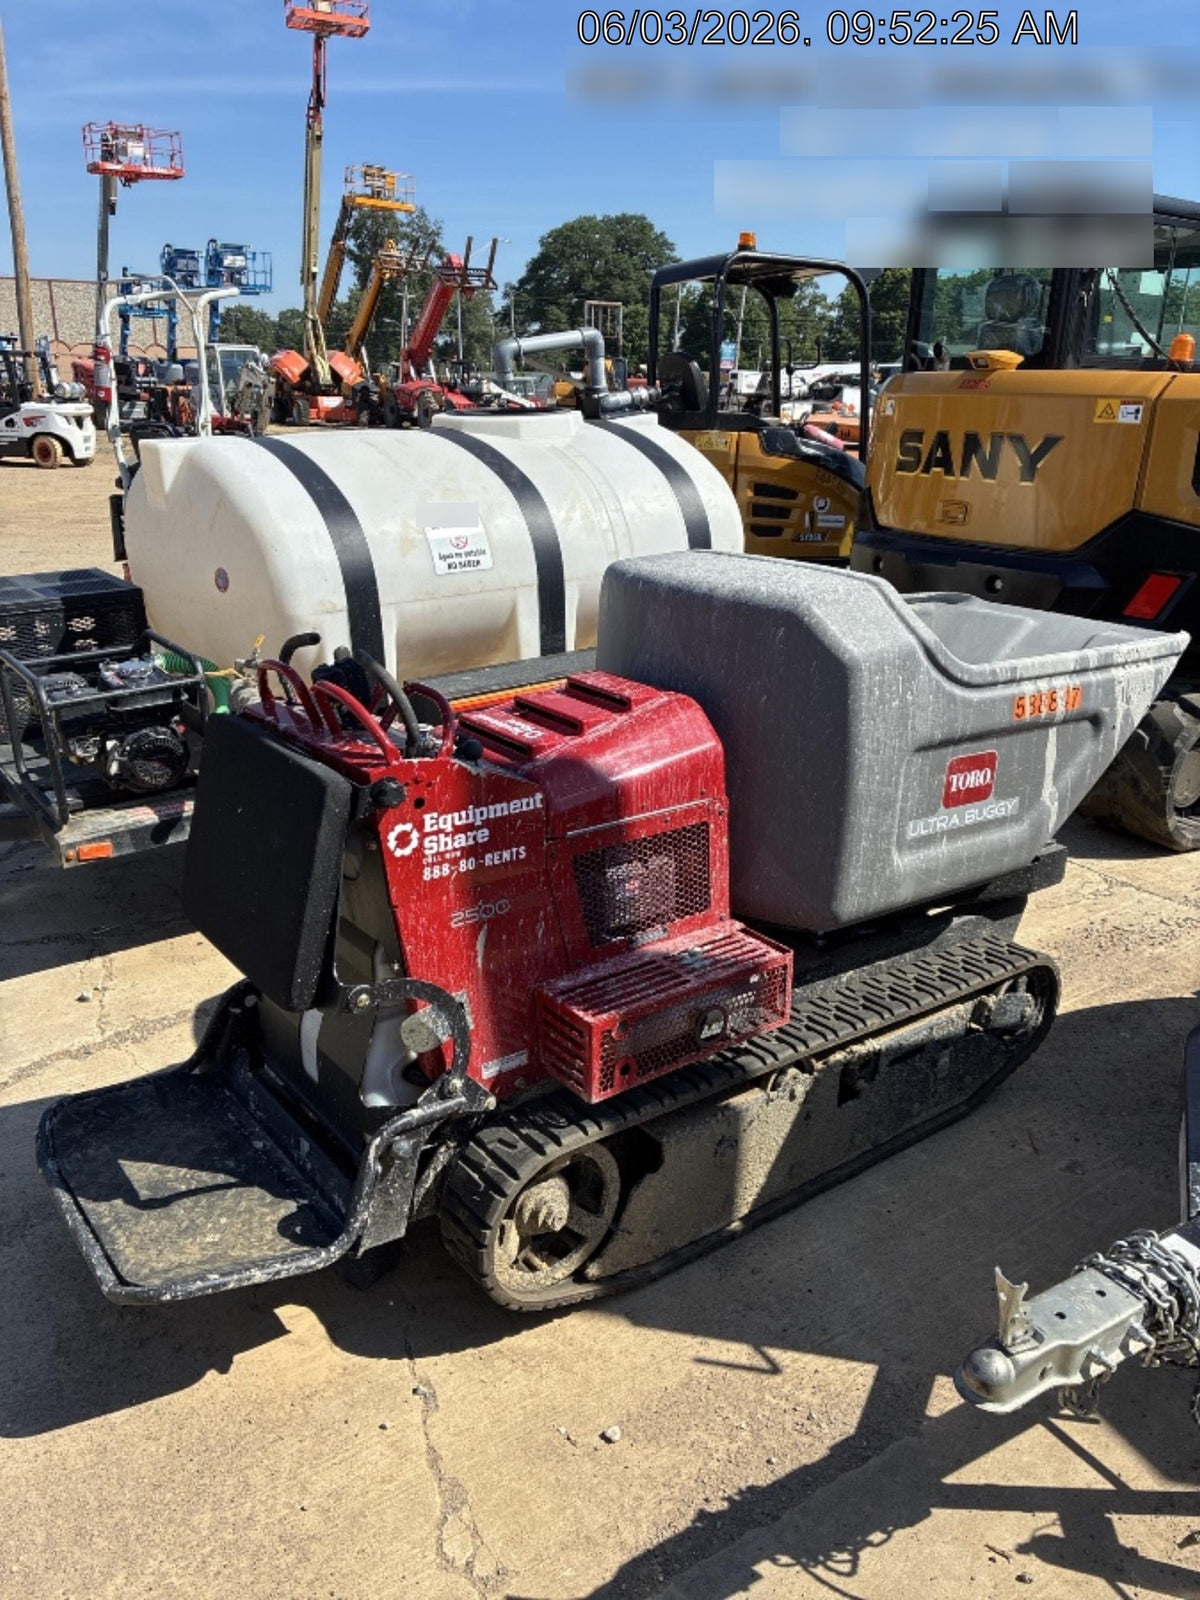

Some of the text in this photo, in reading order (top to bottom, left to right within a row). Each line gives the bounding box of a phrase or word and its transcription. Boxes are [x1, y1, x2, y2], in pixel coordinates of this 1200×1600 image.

[895, 428, 1065, 486] SANY
[950, 768, 992, 792] TORO
[423, 792, 543, 832] Equipment
[909, 801, 1016, 836] ULTRA BUGGY
[423, 827, 490, 855] Share
[450, 899, 511, 928] 2500
